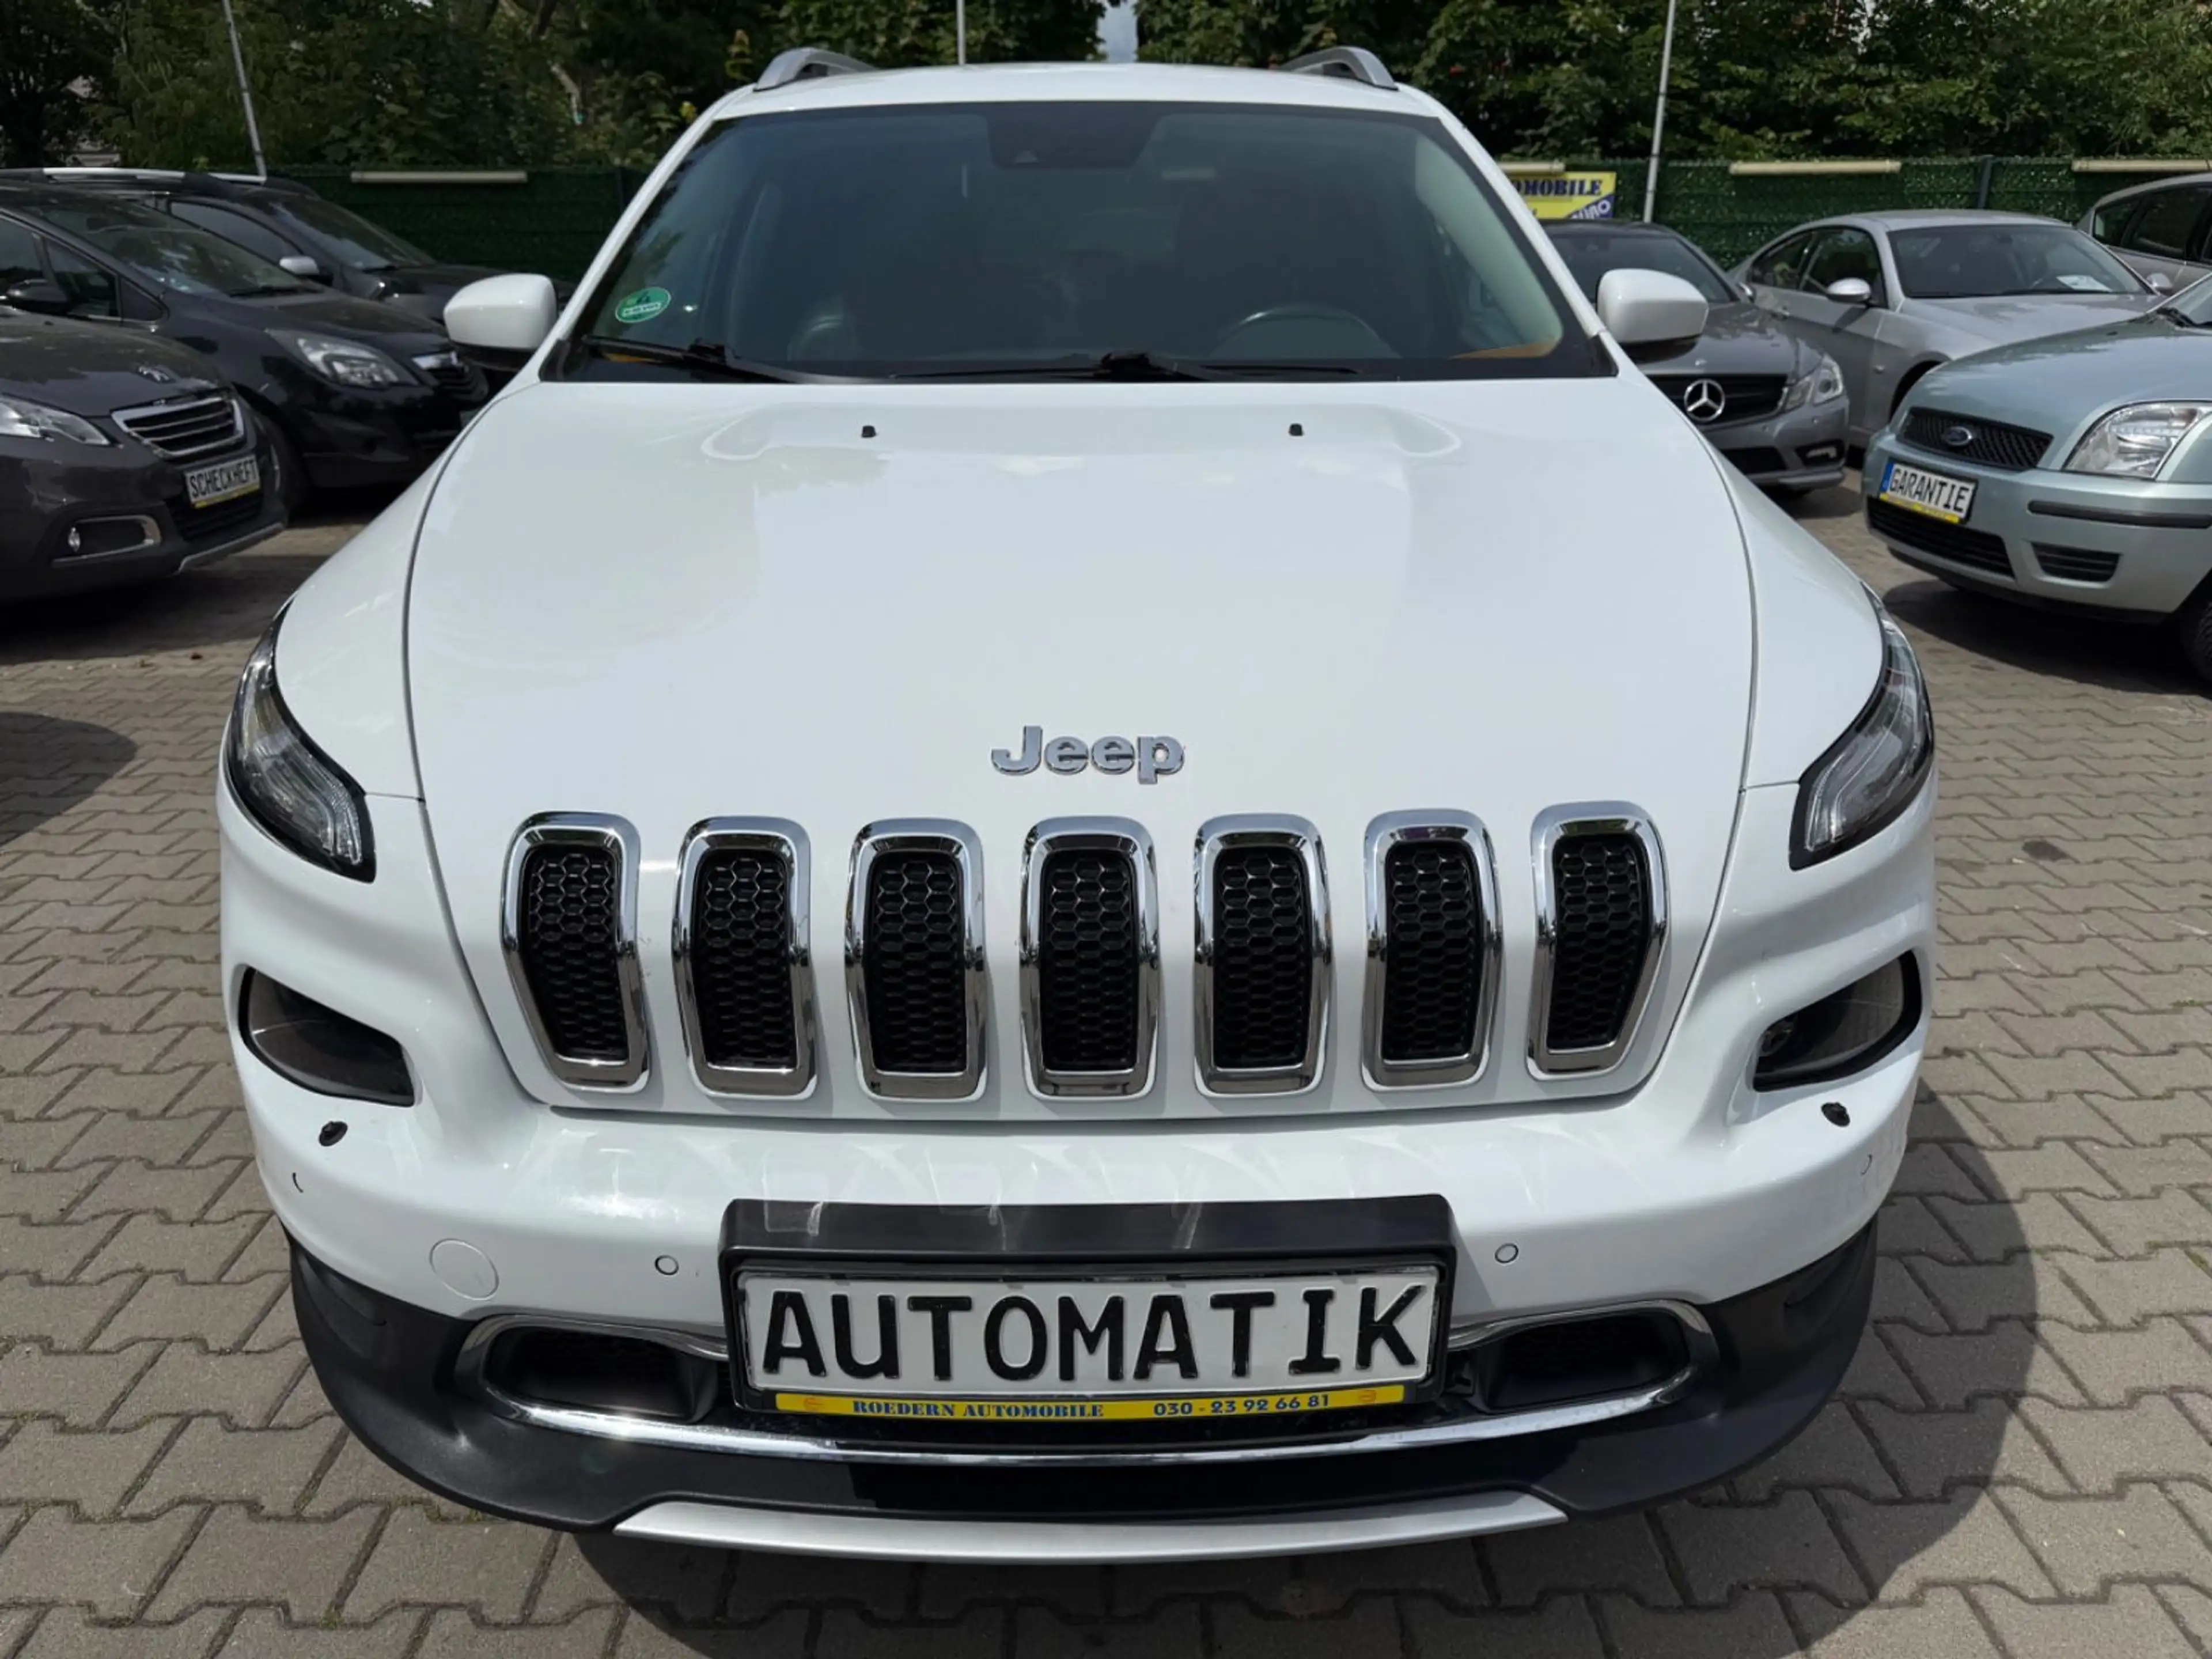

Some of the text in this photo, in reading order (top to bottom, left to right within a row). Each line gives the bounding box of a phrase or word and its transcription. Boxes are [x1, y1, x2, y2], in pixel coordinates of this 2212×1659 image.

[189, 459, 256, 498] SCHECKHEFT
[1889, 467, 1970, 513] GARANTIE
[990, 725, 1185, 785] Jeep
[761, 1285, 1427, 1382] AUTOMATIK
[853, 1400, 955, 1418] ROEDERN
[963, 1404, 1104, 1418] AUTOMOBILE
[1153, 1402, 1193, 1416] 030
[1210, 1400, 1237, 1414] 23
[1243, 1398, 1270, 1412] 92
[1274, 1396, 1301, 1411] 66
[1307, 1393, 1330, 1408] 81
